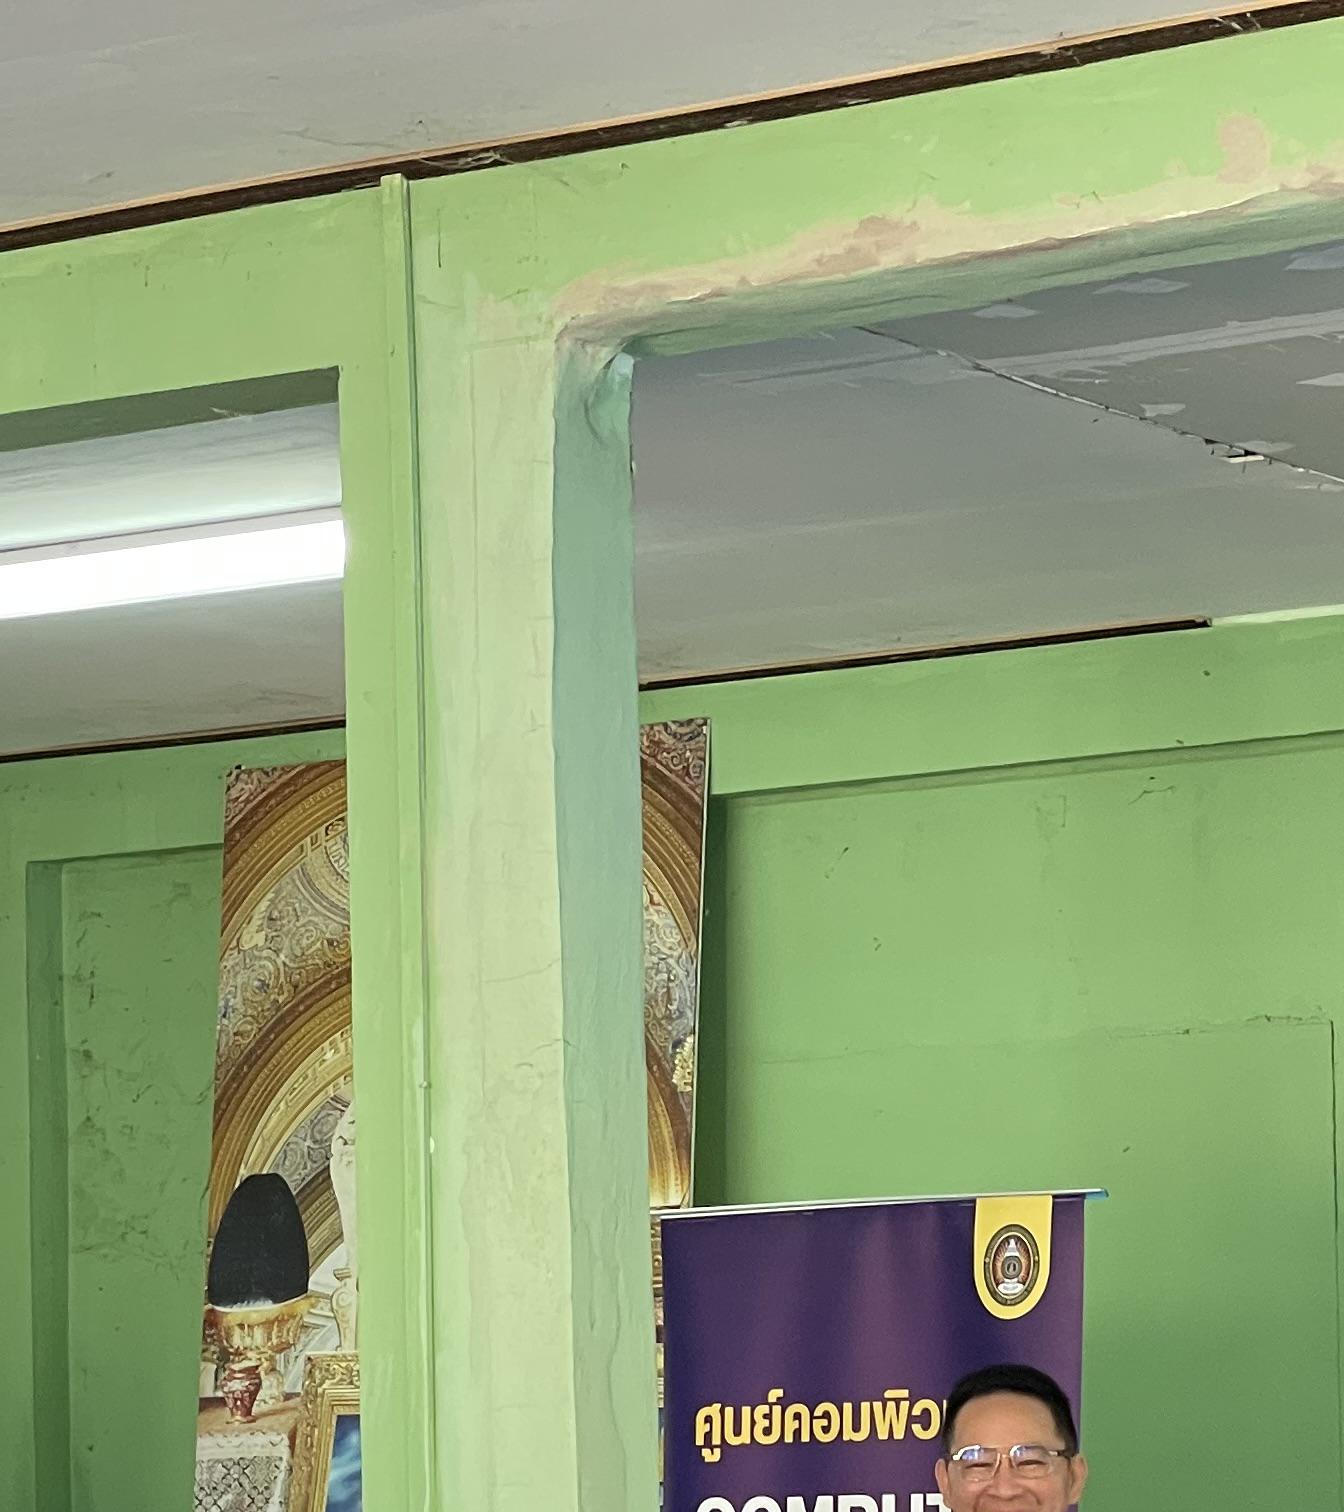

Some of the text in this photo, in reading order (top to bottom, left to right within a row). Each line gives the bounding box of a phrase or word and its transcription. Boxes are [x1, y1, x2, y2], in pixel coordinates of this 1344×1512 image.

[693, 1387, 947, 1463] ศูนย์คอมพิว
